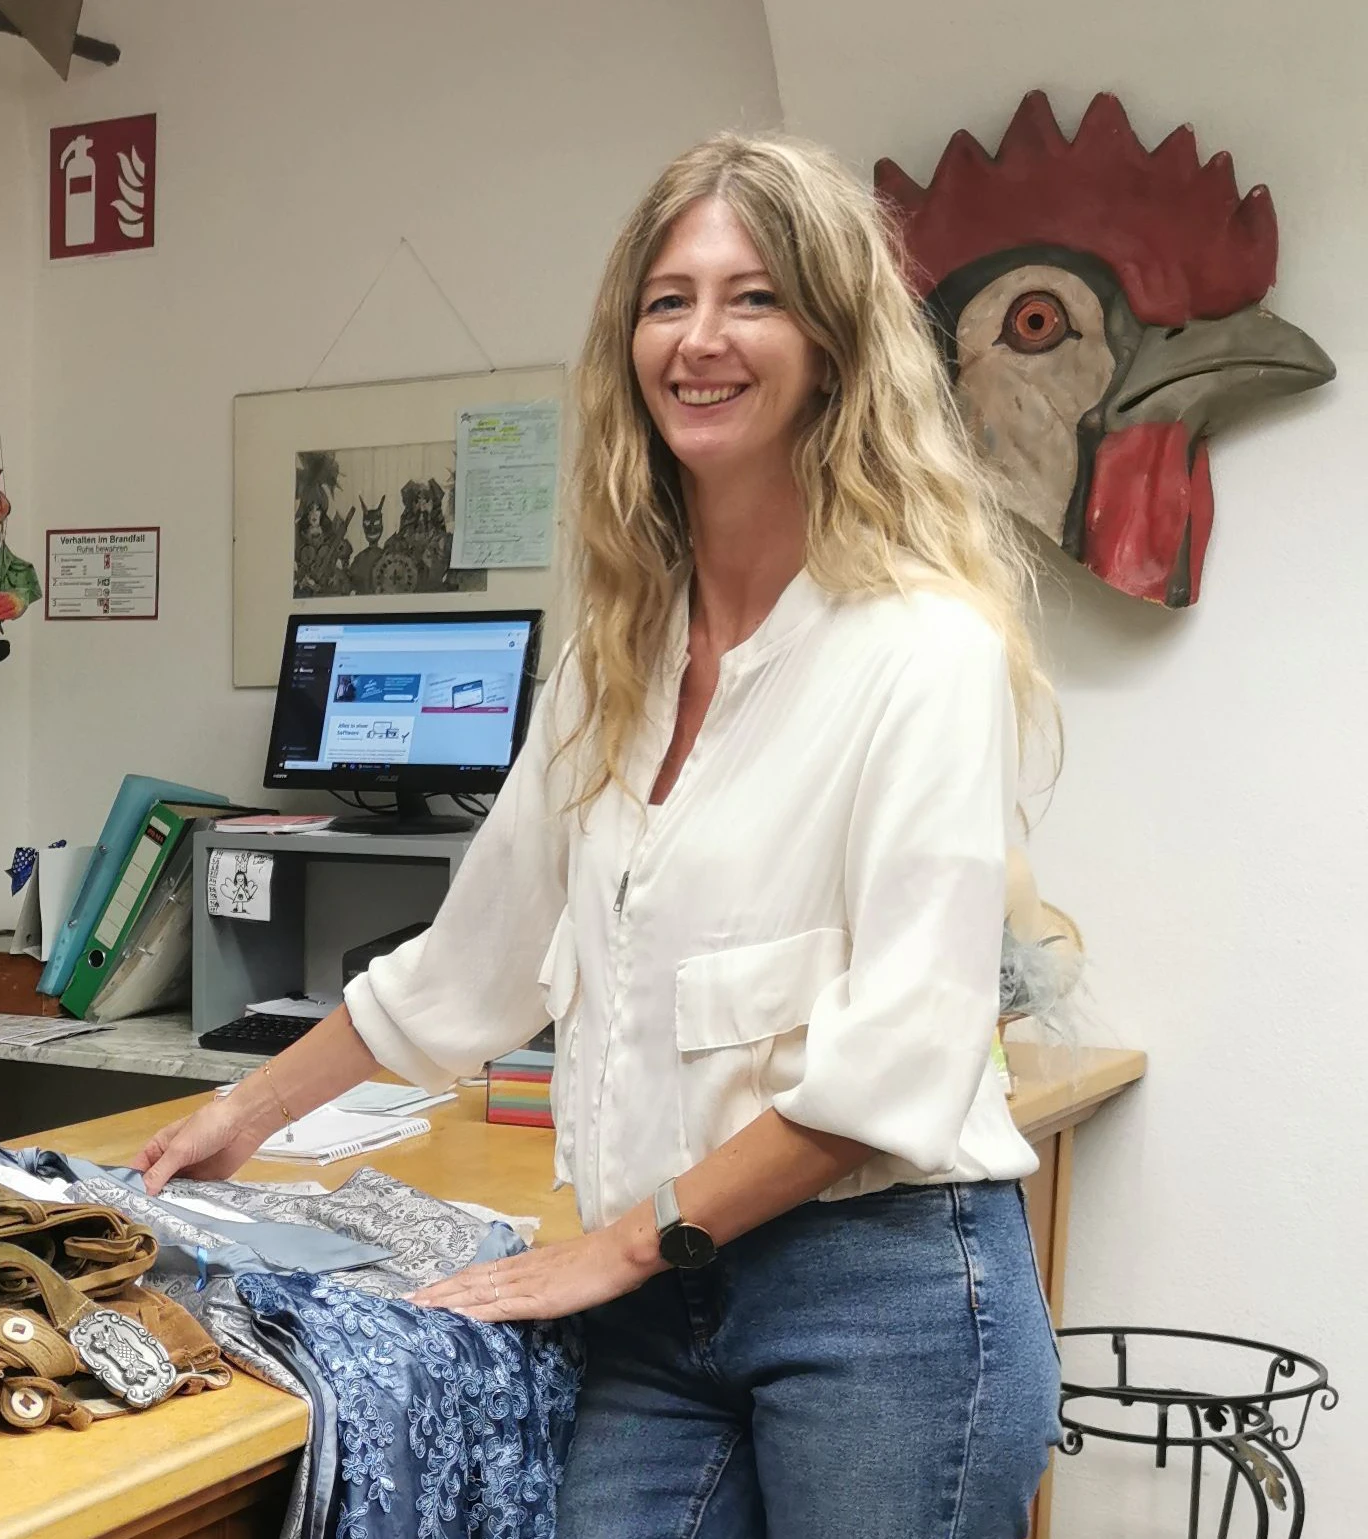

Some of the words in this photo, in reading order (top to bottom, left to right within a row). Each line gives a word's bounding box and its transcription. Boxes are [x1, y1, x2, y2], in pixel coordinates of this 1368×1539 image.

[60, 536, 96, 545] Verhalten
[98, 535, 108, 544] im
[109, 534, 145, 543] Brandfall
